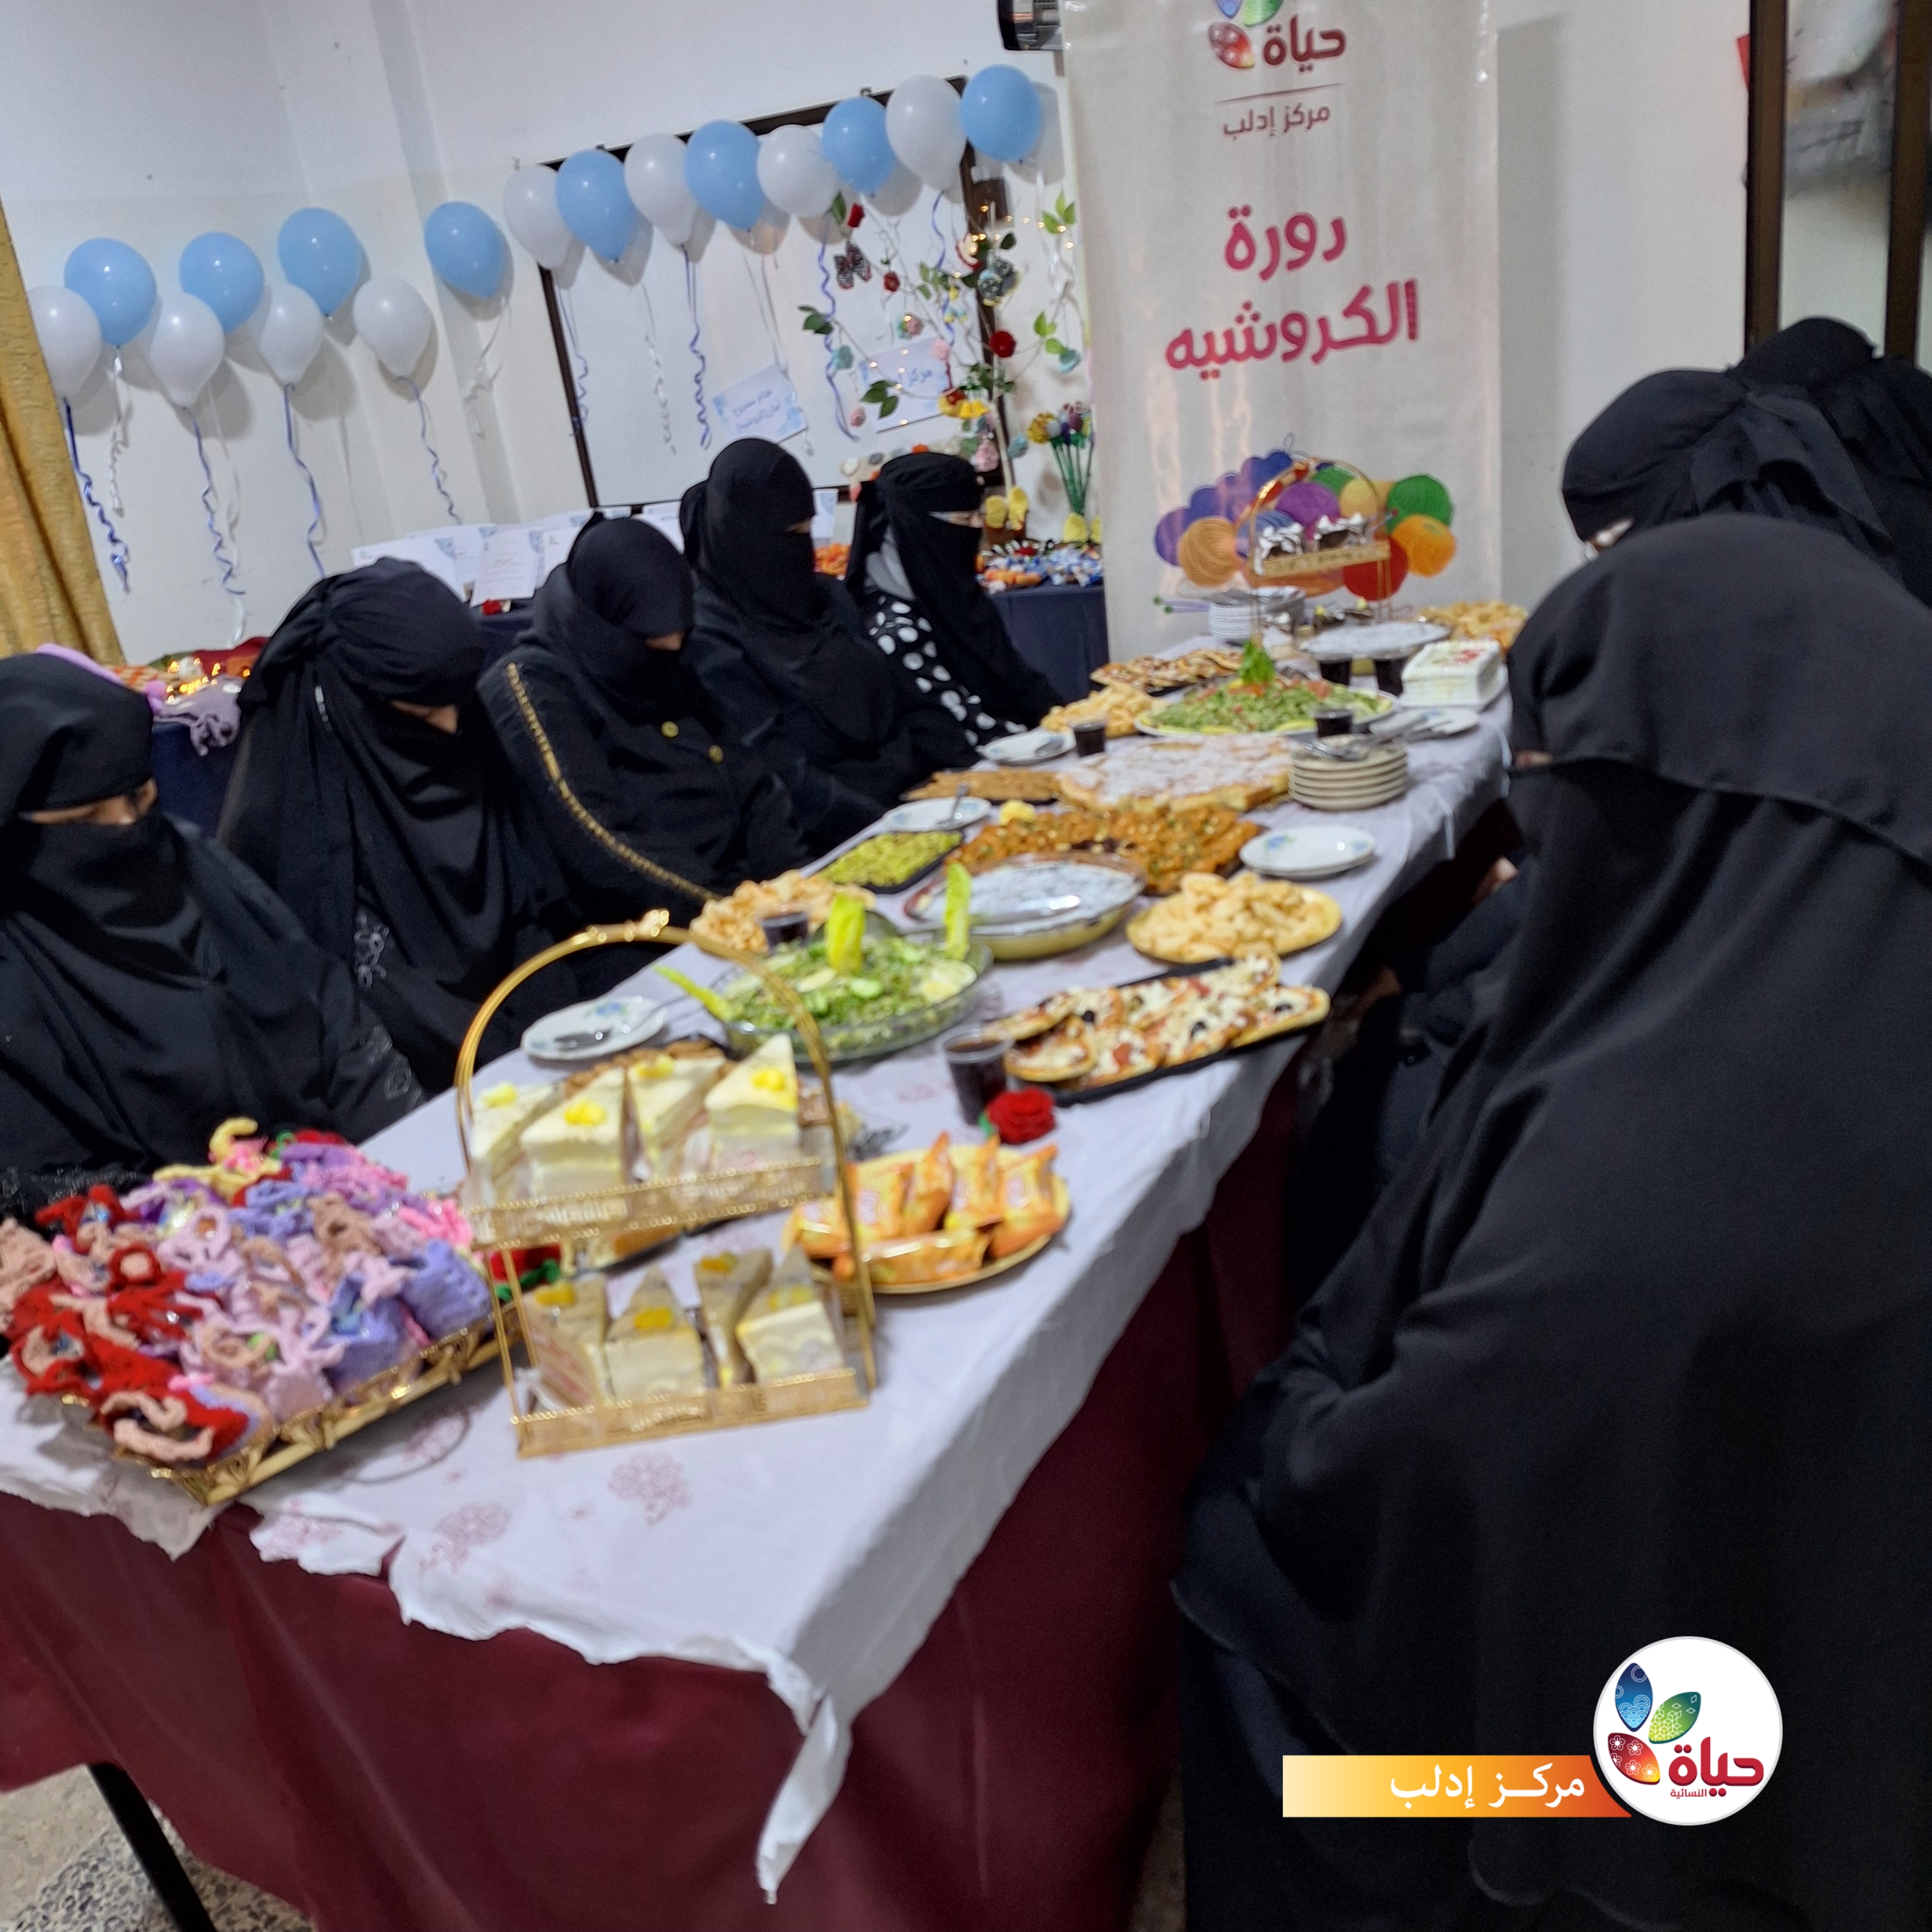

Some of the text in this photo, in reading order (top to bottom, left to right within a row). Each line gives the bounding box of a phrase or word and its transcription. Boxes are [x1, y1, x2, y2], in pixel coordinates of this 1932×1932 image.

[1263, 13, 1345, 72] حياة
[1223, 102, 1331, 139] مركز إدلب
[1224, 205, 1347, 281] دورة
[1165, 279, 1417, 381] الكروشيه
